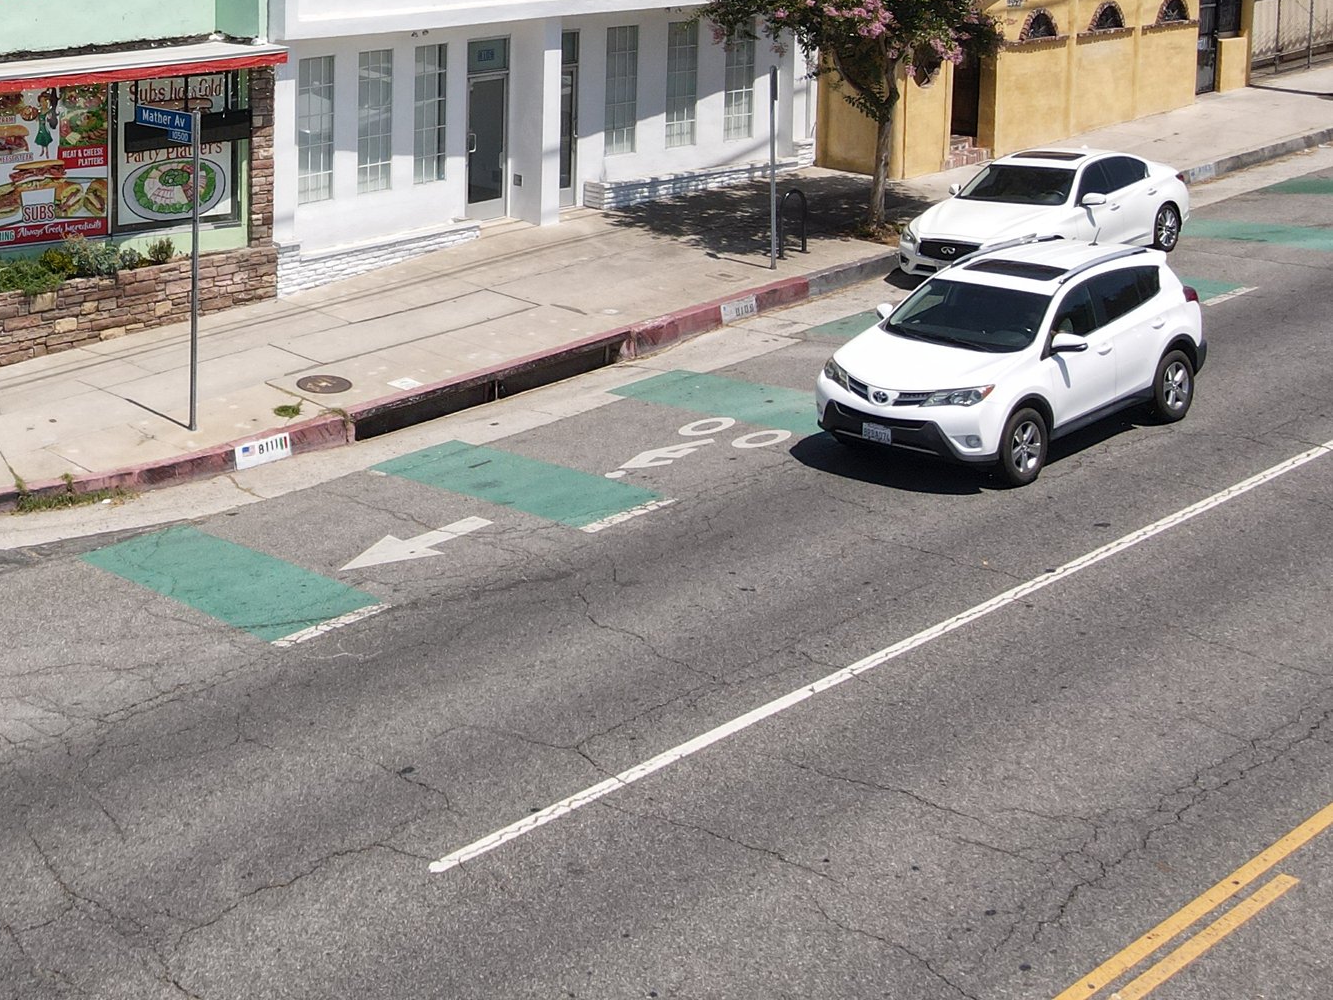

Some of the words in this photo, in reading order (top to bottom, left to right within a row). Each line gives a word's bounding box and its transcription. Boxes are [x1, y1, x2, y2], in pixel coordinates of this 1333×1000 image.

[142, 109, 172, 125] Mather
[174, 116, 185, 127] Av
[172, 131, 188, 141] 10500
[83, 147, 103, 156] CHEESE
[167, 142, 222, 159] Platers
[22, 203, 56, 222] SUBS
[258, 437, 279, 455] 8111
